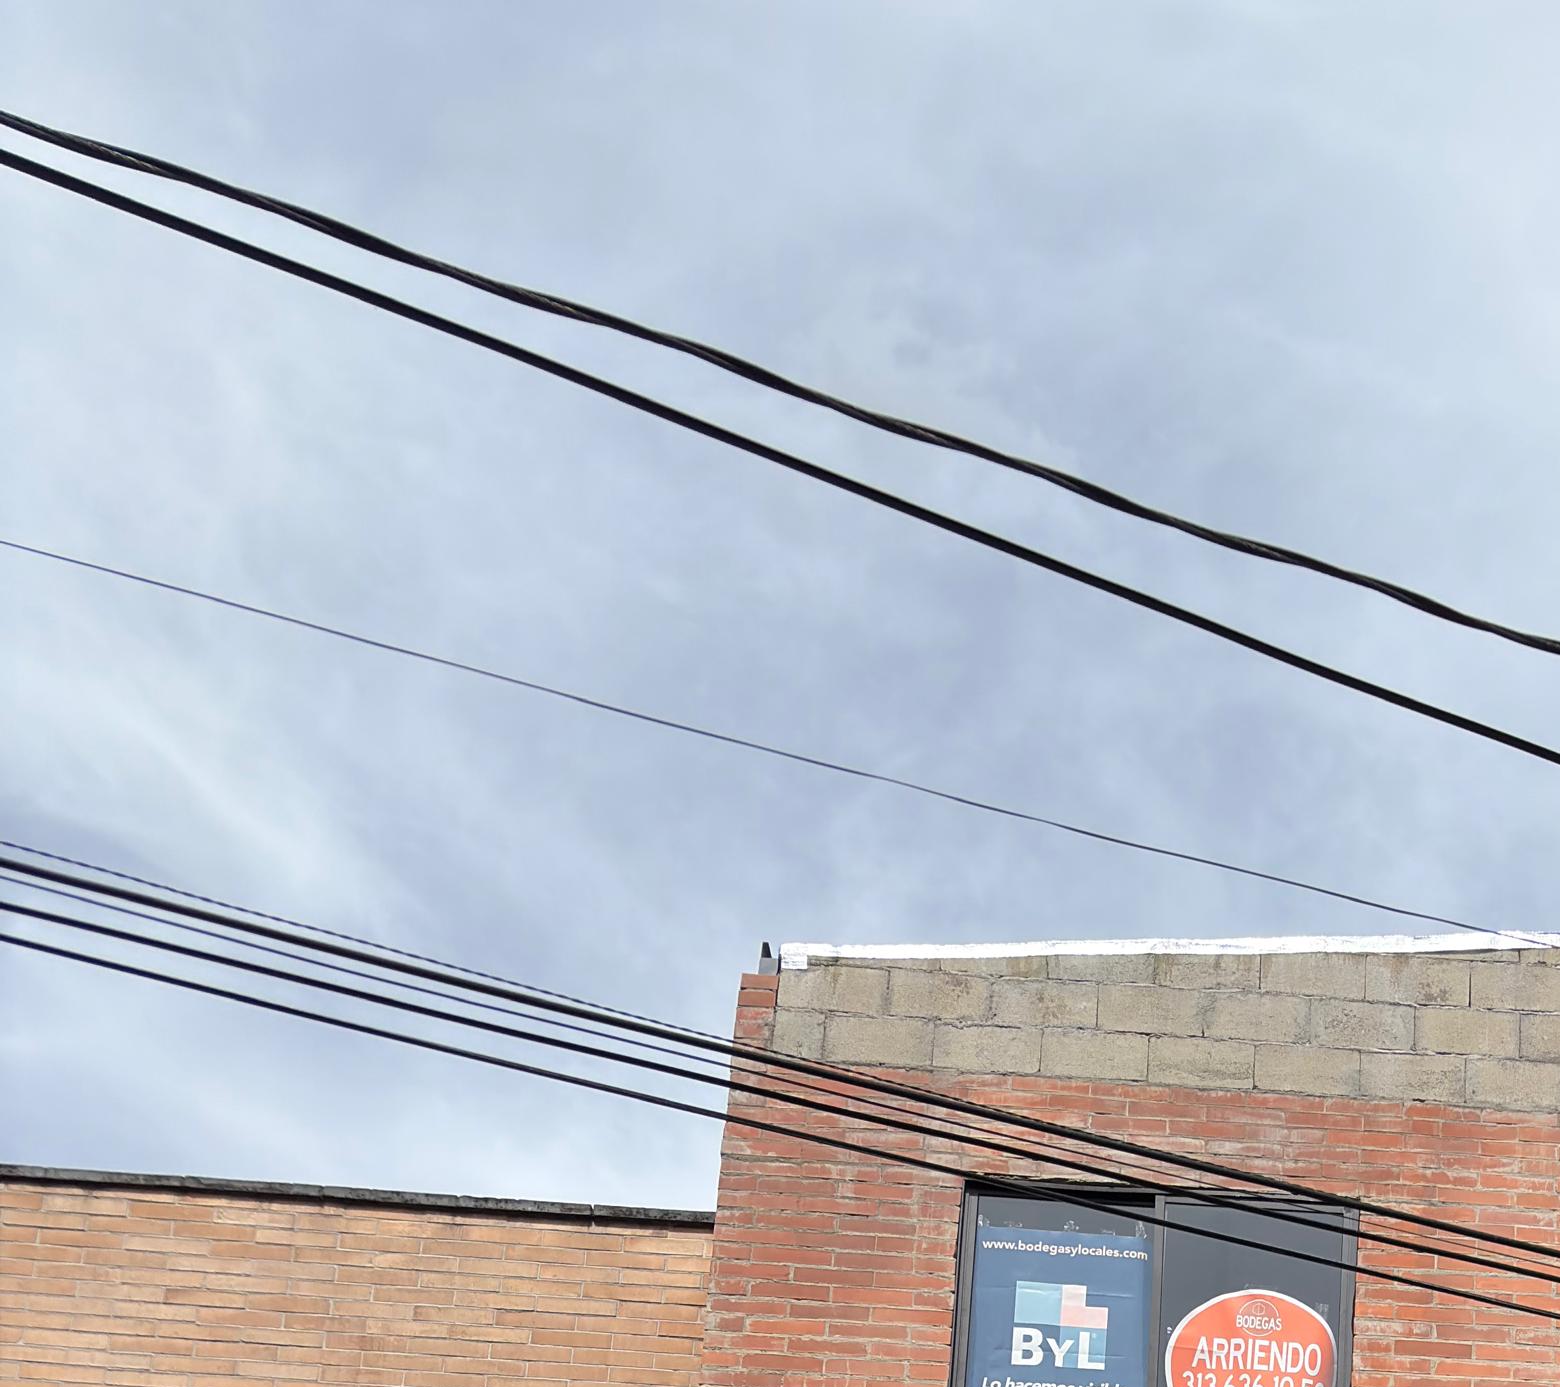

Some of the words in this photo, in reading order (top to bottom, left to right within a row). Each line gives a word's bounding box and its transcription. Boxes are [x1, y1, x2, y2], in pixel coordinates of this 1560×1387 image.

[982, 1239, 1148, 1261] www.bodegasylocales.com
[1236, 1315, 1282, 1331] BODEGAS
[1192, 1336, 1322, 1376] ARRIENDO
